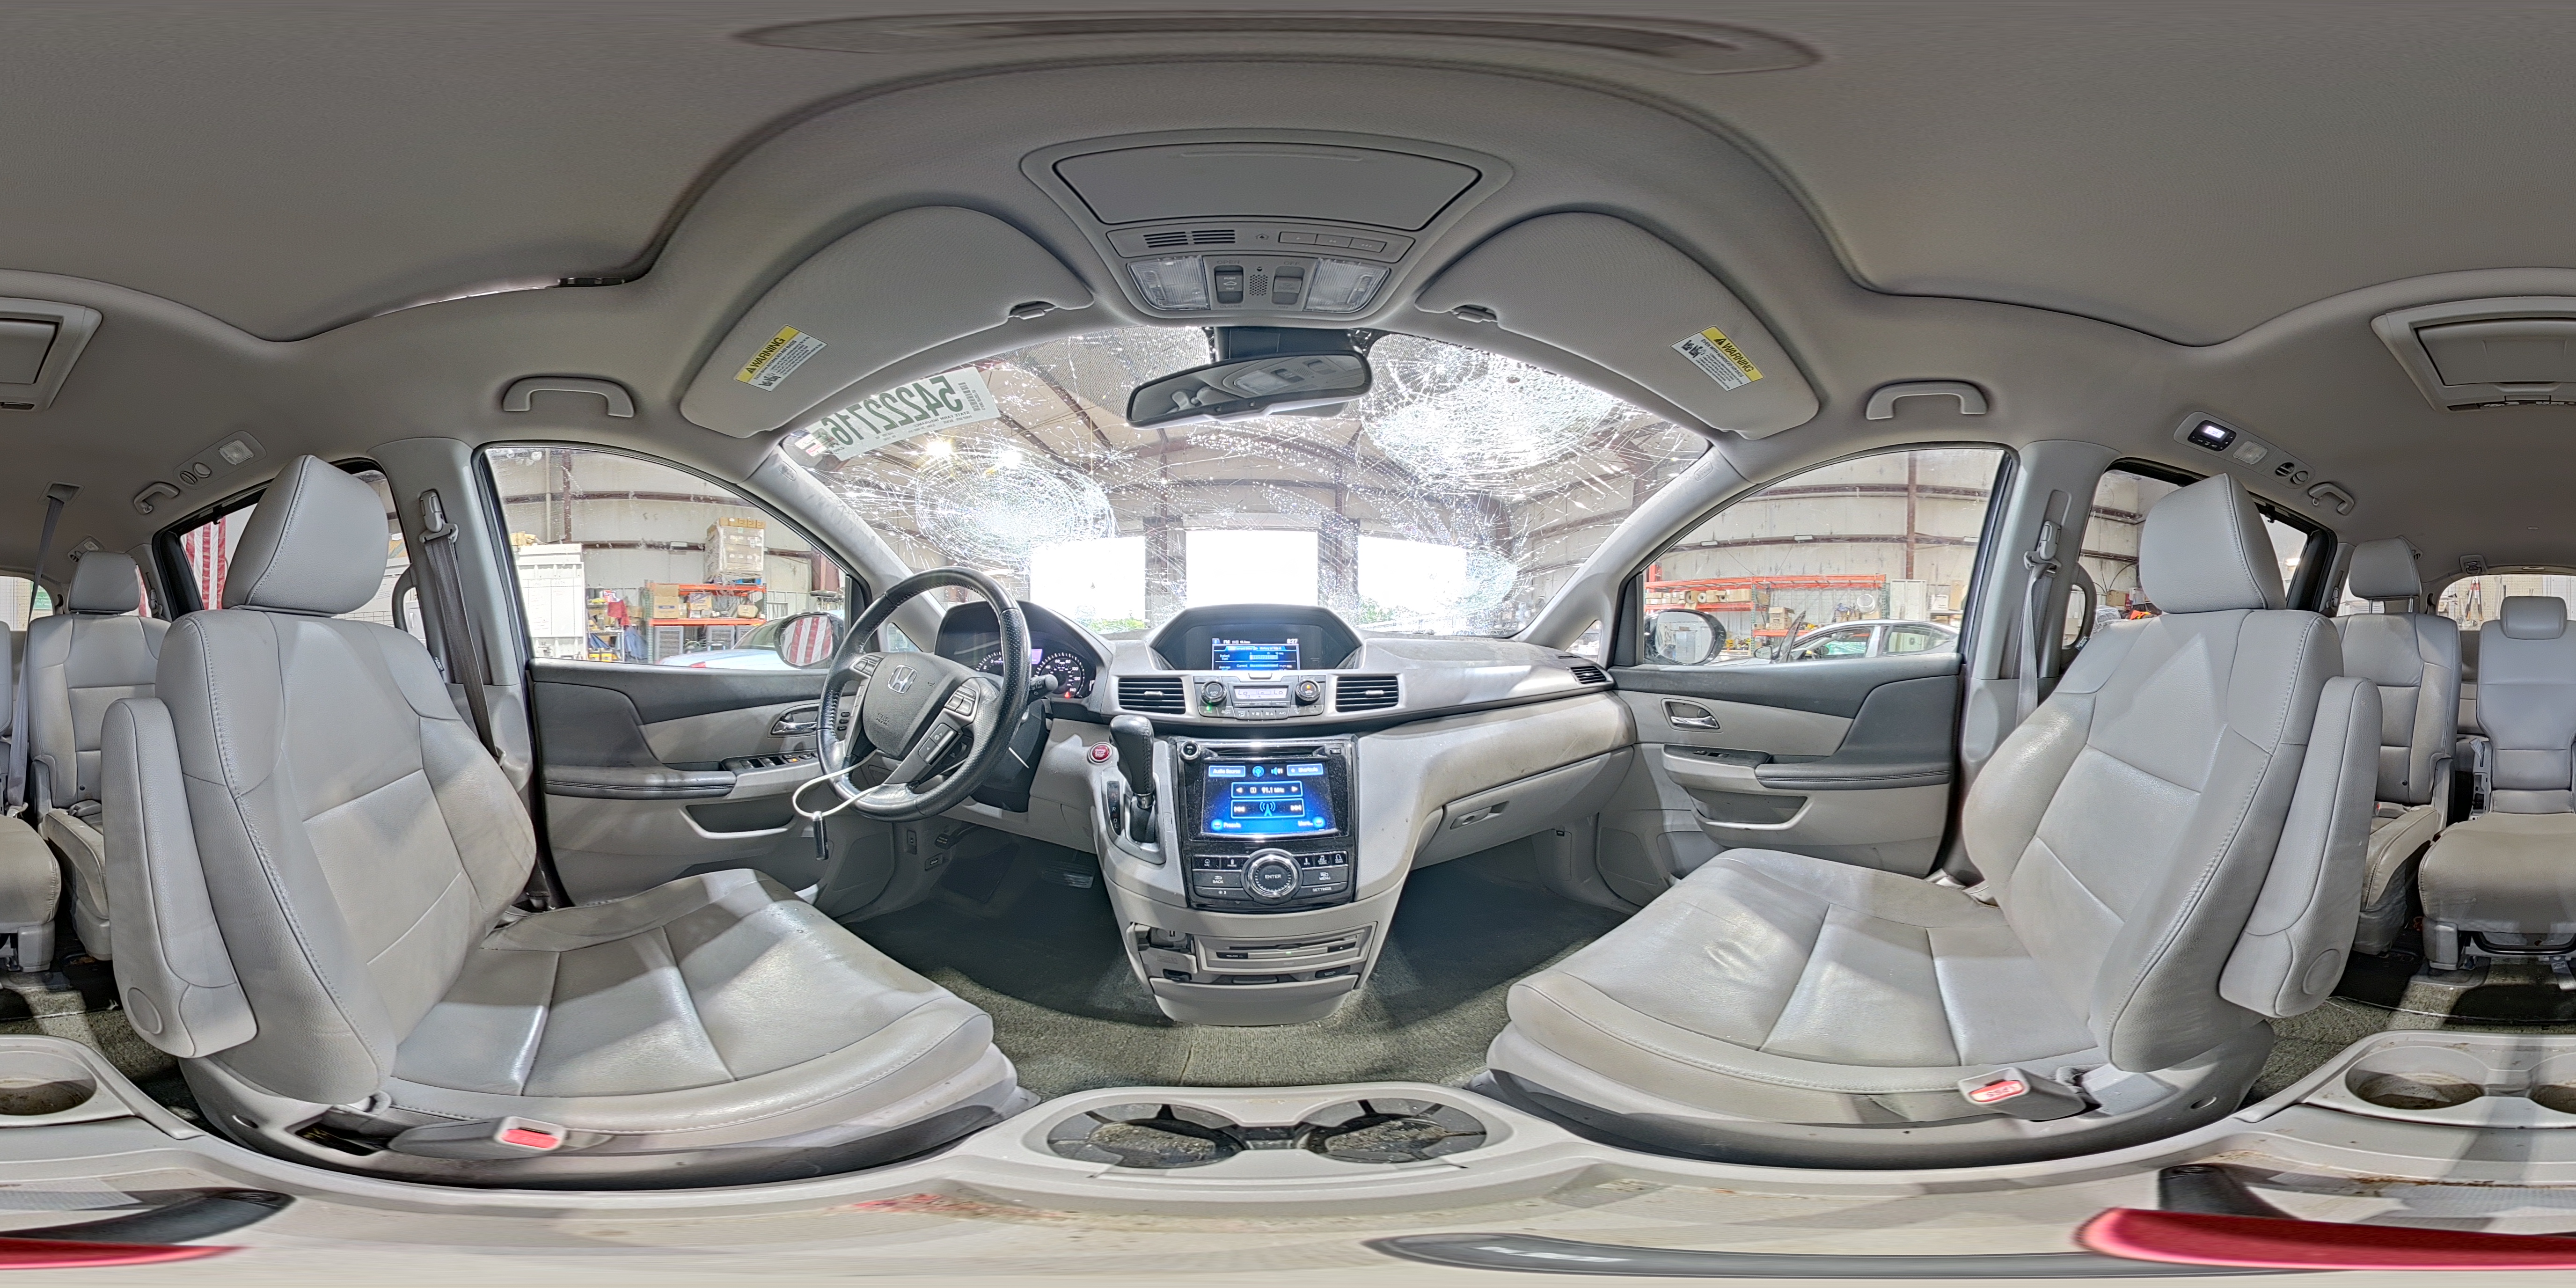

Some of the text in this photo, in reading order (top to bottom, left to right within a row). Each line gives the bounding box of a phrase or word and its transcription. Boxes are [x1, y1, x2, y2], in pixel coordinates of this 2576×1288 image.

[750, 337, 786, 367] WARNING
[767, 352, 783, 368] ADVANCED
[786, 340, 797, 349] BAGS
[1700, 338, 1711, 347] EVEN
[1709, 345, 1720, 354] WITH
[1716, 352, 1733, 367] ADVANCED
[1734, 368, 1744, 377] BAGS
[1722, 342, 1754, 373] WARNING
